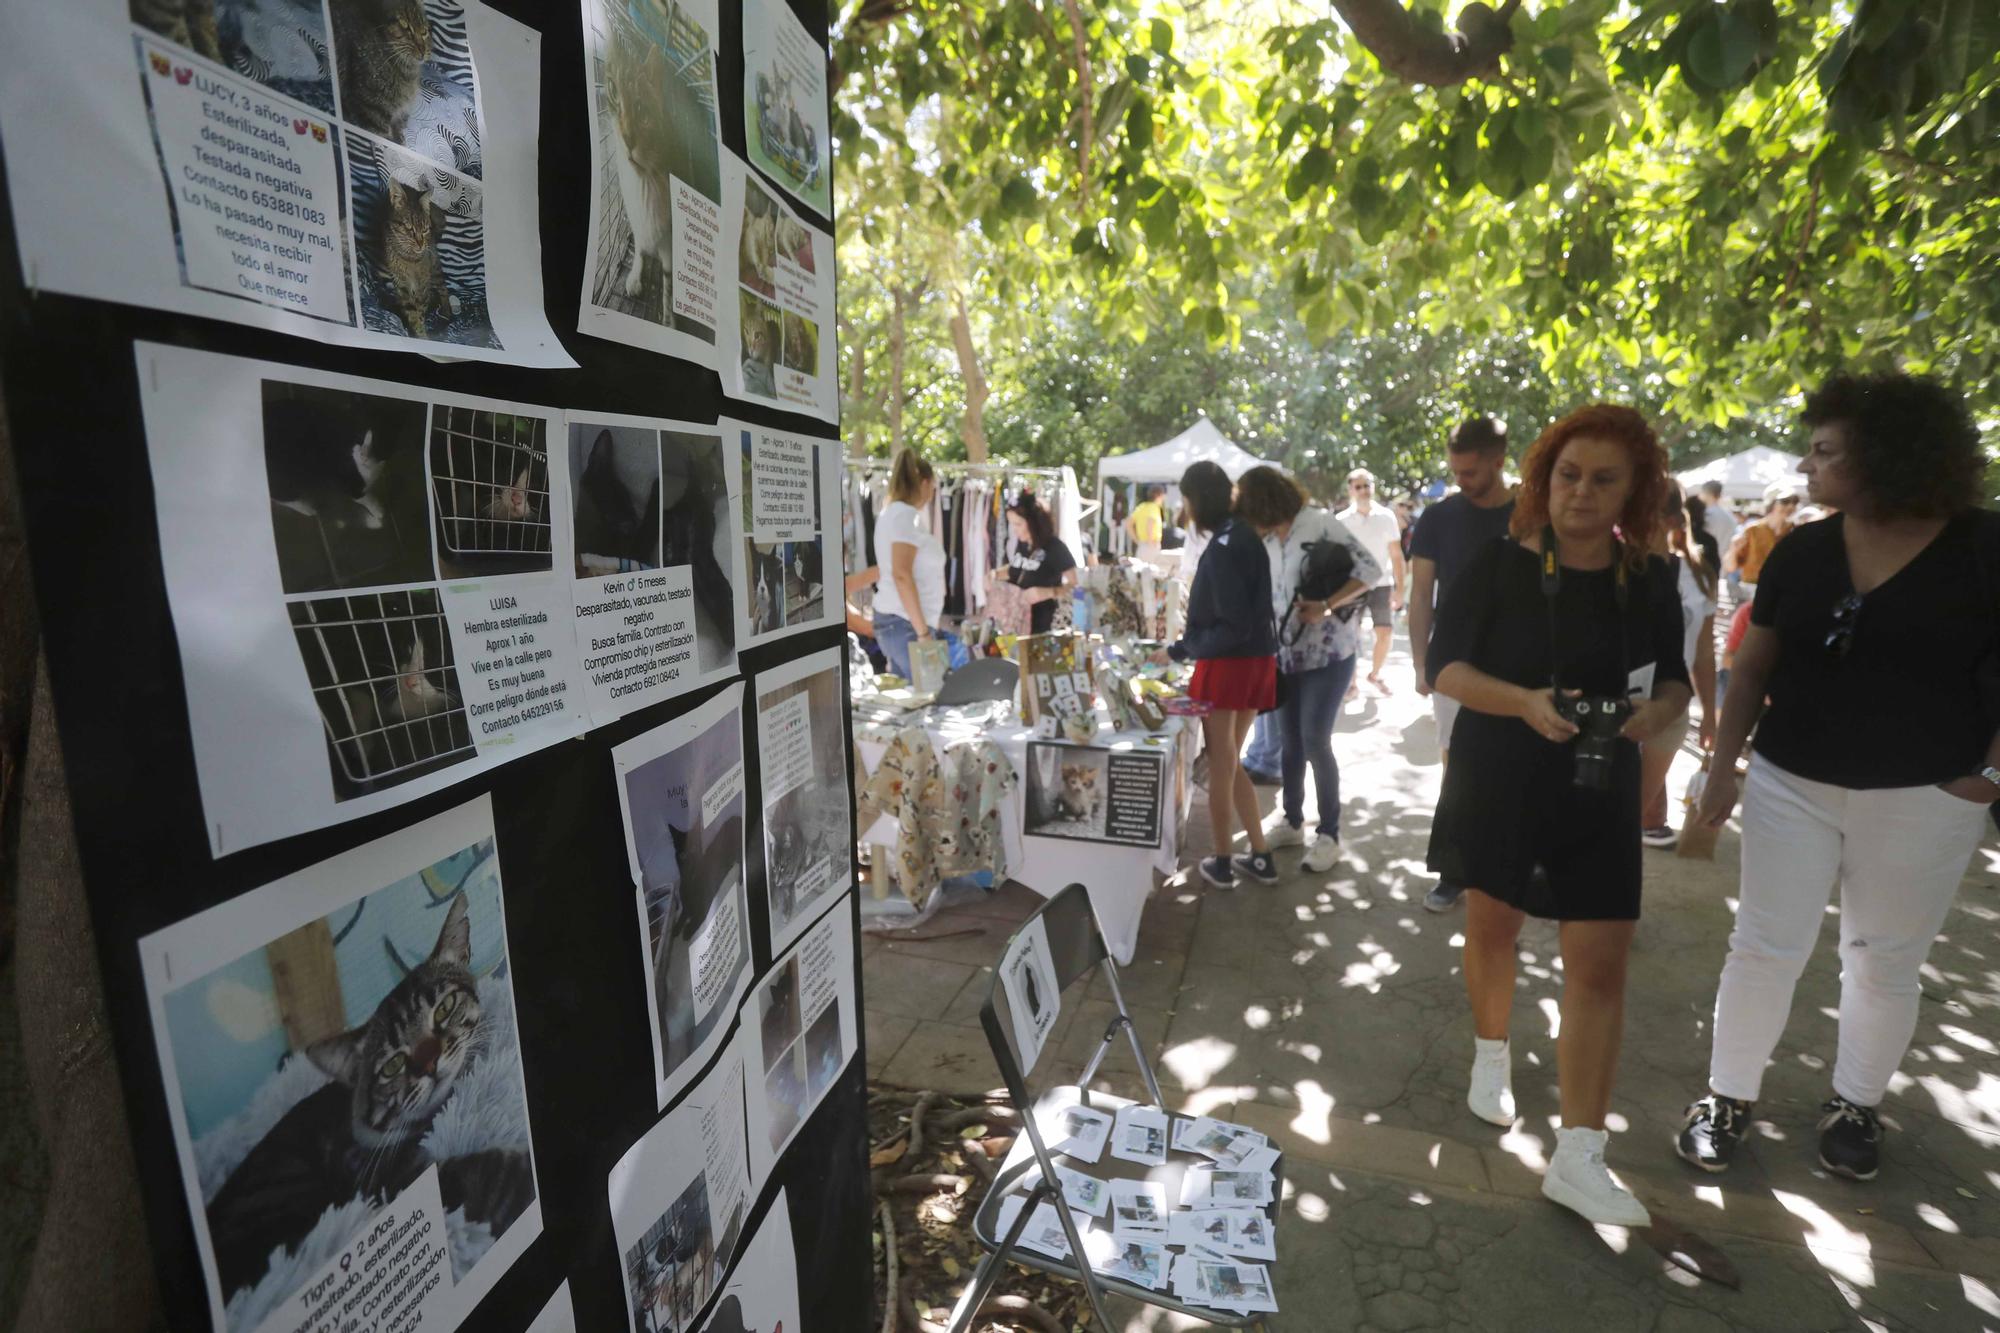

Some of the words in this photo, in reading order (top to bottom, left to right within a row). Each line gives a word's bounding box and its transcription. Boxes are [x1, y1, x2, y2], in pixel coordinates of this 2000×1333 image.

[195, 75, 238, 108] LUCY,
[241, 96, 251, 111] 3
[255, 102, 289, 127] años
[202, 102, 290, 150] Esterilizada,
[201, 126, 301, 174] desparasitada
[193, 145, 251, 179] Testada
[255, 172, 312, 199] negativa
[183, 165, 248, 201] Contacto
[252, 191, 325, 225] 653881083
[183, 187, 201, 205] Lo
[204, 195, 222, 214] ha
[225, 205, 274, 231] pasado
[277, 224, 304, 244] muy
[308, 232, 334, 251] mal,
[216, 224, 270, 252] necesita
[274, 240, 313, 264] recibir
[232, 251, 261, 271] todo
[264, 260, 274, 275] el
[278, 267, 308, 284] amor
[238, 274, 263, 293] Que
[265, 285, 308, 305] merece
[603, 582, 624, 594] Kevin
[638, 577, 643, 589] 5
[644, 575, 666, 588] meses
[490, 596, 517, 611] LUISA
[576, 599, 633, 618] Desparasitado,
[633, 592, 667, 607] vacunado,
[668, 588, 691, 603] testado
[624, 611, 654, 629] negativo
[464, 618, 499, 634] Hembra
[500, 612, 547, 629] esterilizada
[592, 636, 616, 651] Busca
[617, 629, 643, 646] familia.
[644, 623, 672, 638] Contrato
[673, 621, 685, 632] con
[486, 637, 510, 652] Aprox
[512, 636, 516, 646] 1
[517, 632, 534, 645] año
[584, 651, 632, 671] Compromiso
[634, 645, 649, 660] chip
[649, 644, 654, 656] y
[655, 634, 694, 652] esterilización
[472, 659, 491, 675] Vive
[493, 658, 504, 669] en
[505, 655, 513, 667] la
[515, 652, 533, 666] calle
[535, 649, 552, 664] pero
[488, 679, 499, 691] Es
[502, 675, 520, 689] muy
[521, 668, 545, 683] buena
[592, 669, 623, 687] Vivienda
[624, 662, 656, 681] protegida
[658, 651, 690, 669] necesarios
[470, 701, 494, 717] Corre
[496, 693, 524, 712] peligro
[526, 687, 549, 703] dónde
[551, 681, 566, 695] está
[610, 682, 642, 699] Contacto
[644, 670, 679, 689] 692108424
[482, 715, 520, 734] Contacto
[521, 699, 564, 722] 645229156
[364, 1209, 424, 1272] esterilizado,
[301, 1272, 335, 1308] Tigre
[357, 1241, 365, 1256] 2
[368, 1215, 395, 1248] años
[343, 1267, 387, 1315] testado
[389, 1221, 431, 1270] negativo
[362, 1264, 410, 1317] Contrato
[412, 1242, 430, 1266] con
[381, 1247, 446, 1320] esterilización
[386, 1273, 440, 1333] necesarios
